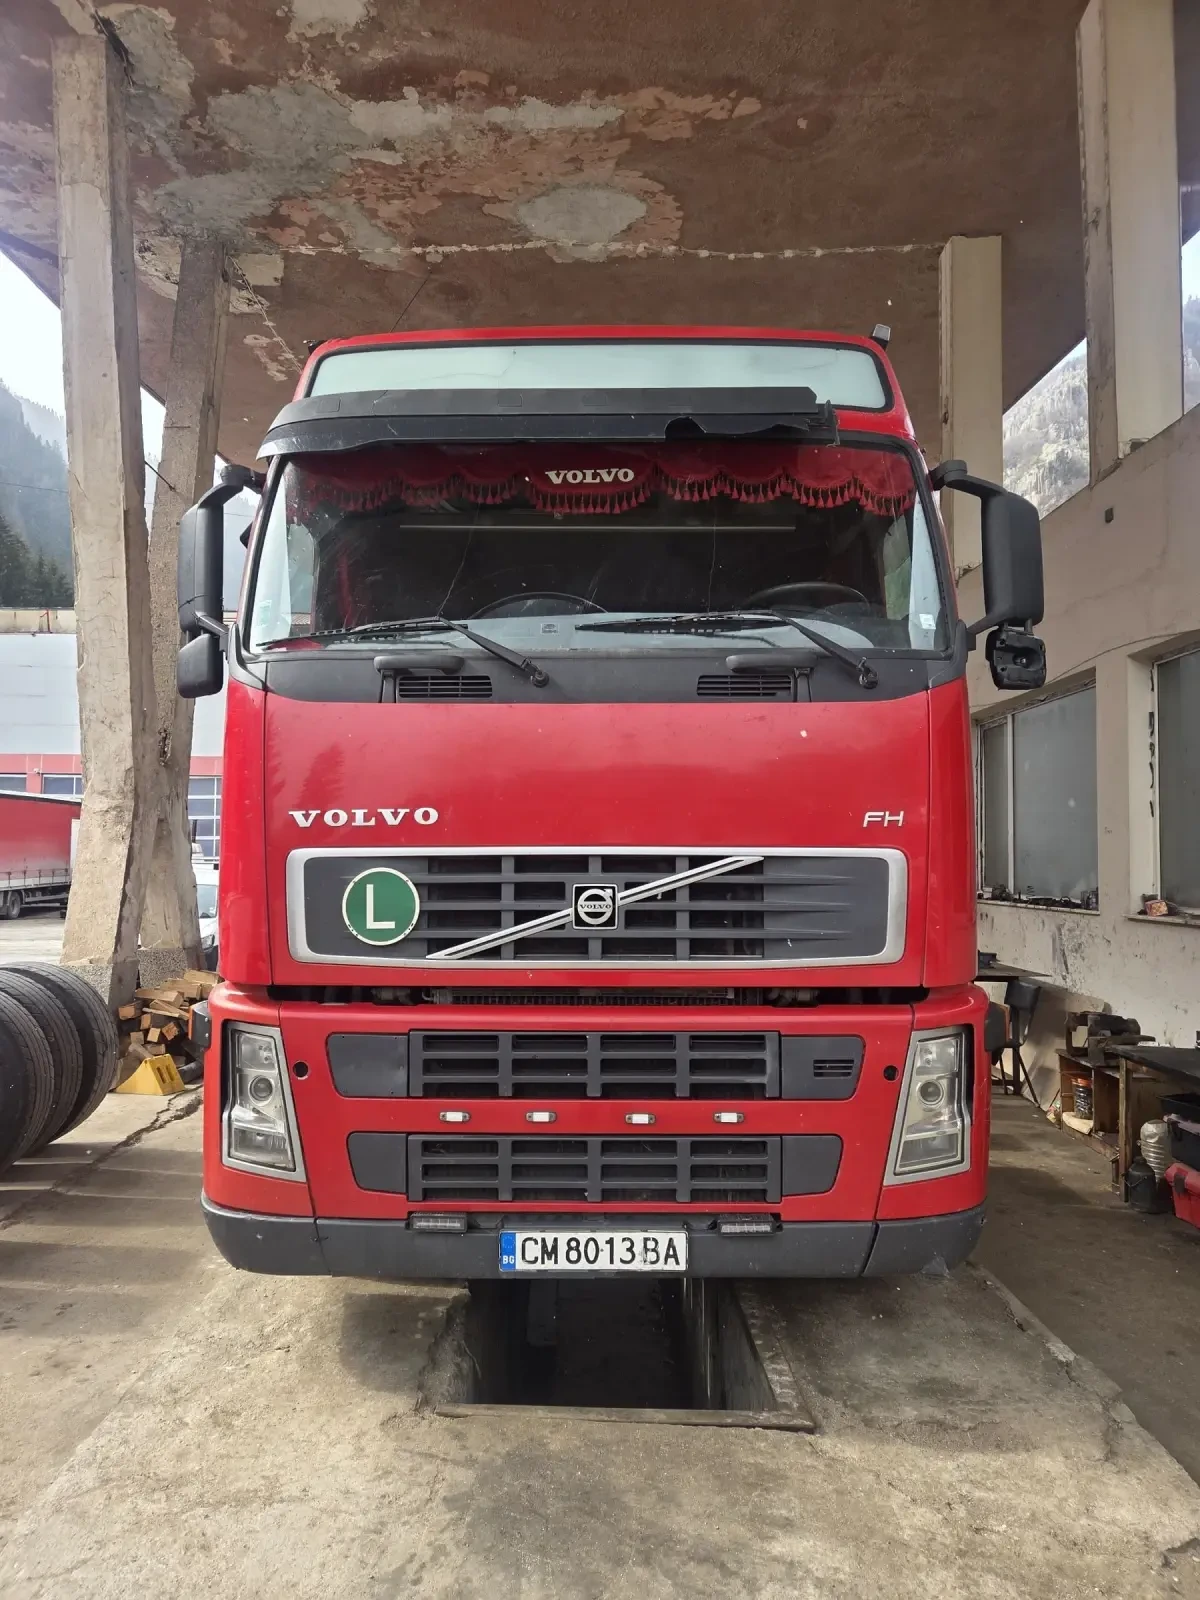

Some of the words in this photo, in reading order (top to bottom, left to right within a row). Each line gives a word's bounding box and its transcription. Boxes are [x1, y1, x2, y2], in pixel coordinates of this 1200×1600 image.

[545, 468, 634, 484] VOLVO
[288, 807, 439, 828] VOLVO
[862, 810, 904, 827] FH
[366, 884, 395, 929] L
[502, 1255, 515, 1264] BG
